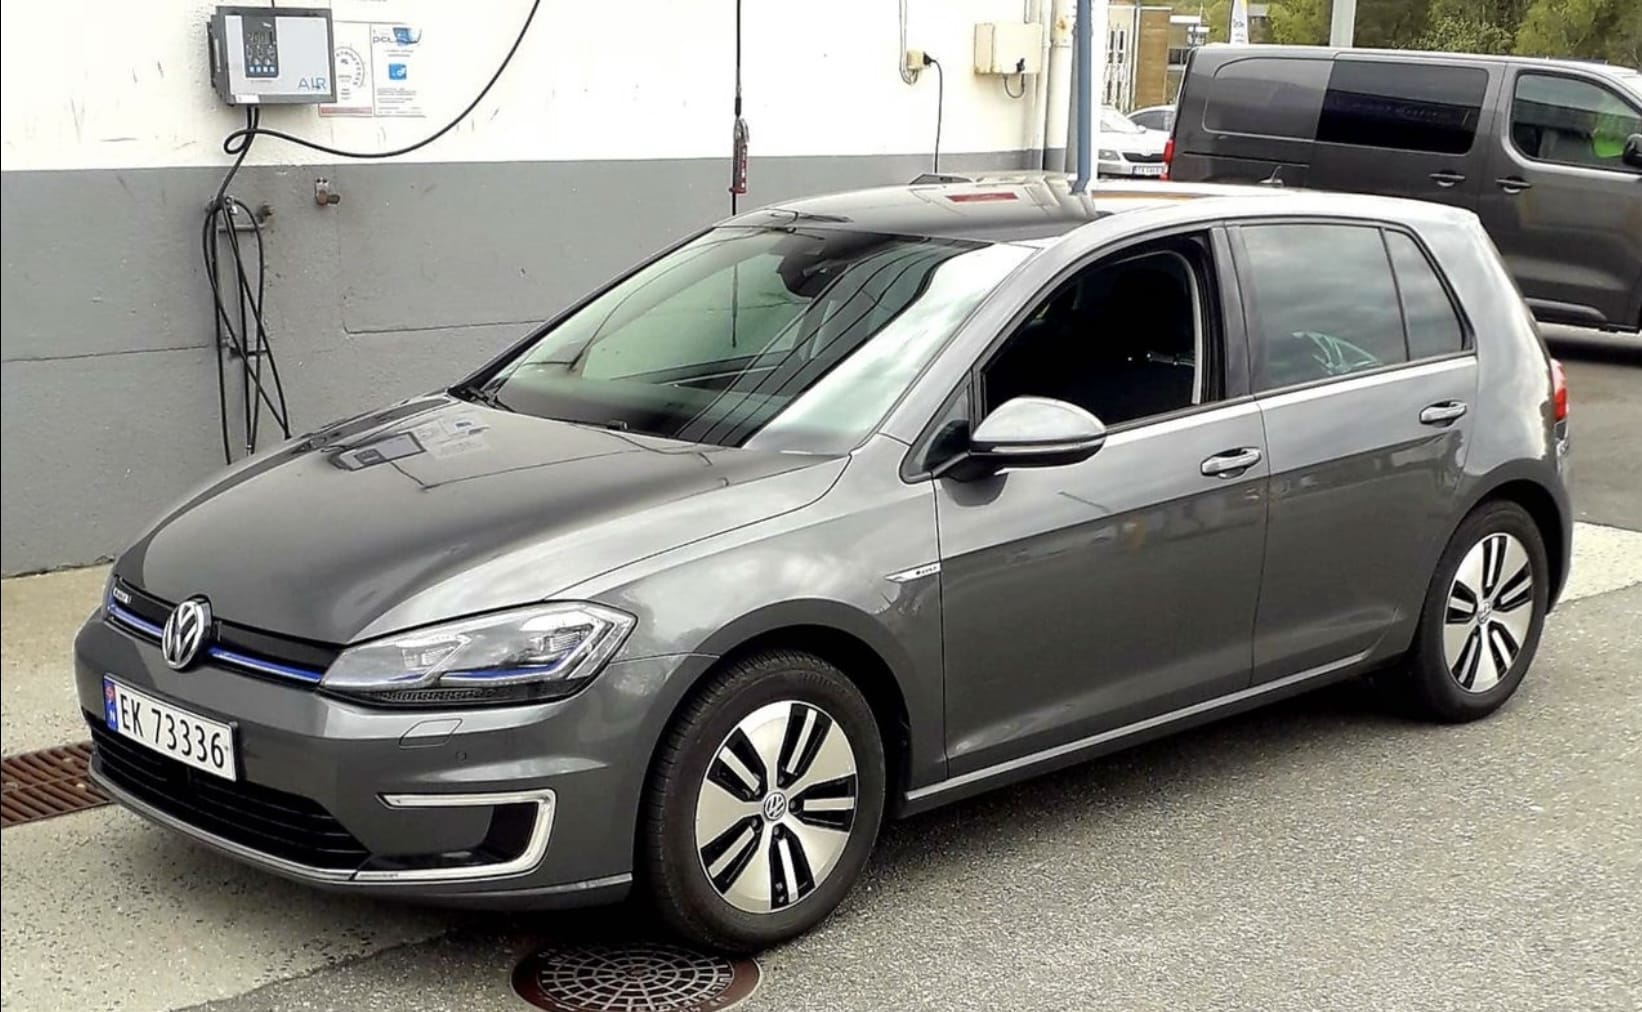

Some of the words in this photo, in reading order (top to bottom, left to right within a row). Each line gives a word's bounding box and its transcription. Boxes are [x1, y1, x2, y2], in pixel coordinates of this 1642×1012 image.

[298, 77, 326, 89] AIR
[120, 693, 144, 738] EK
[151, 708, 225, 769] 73336
